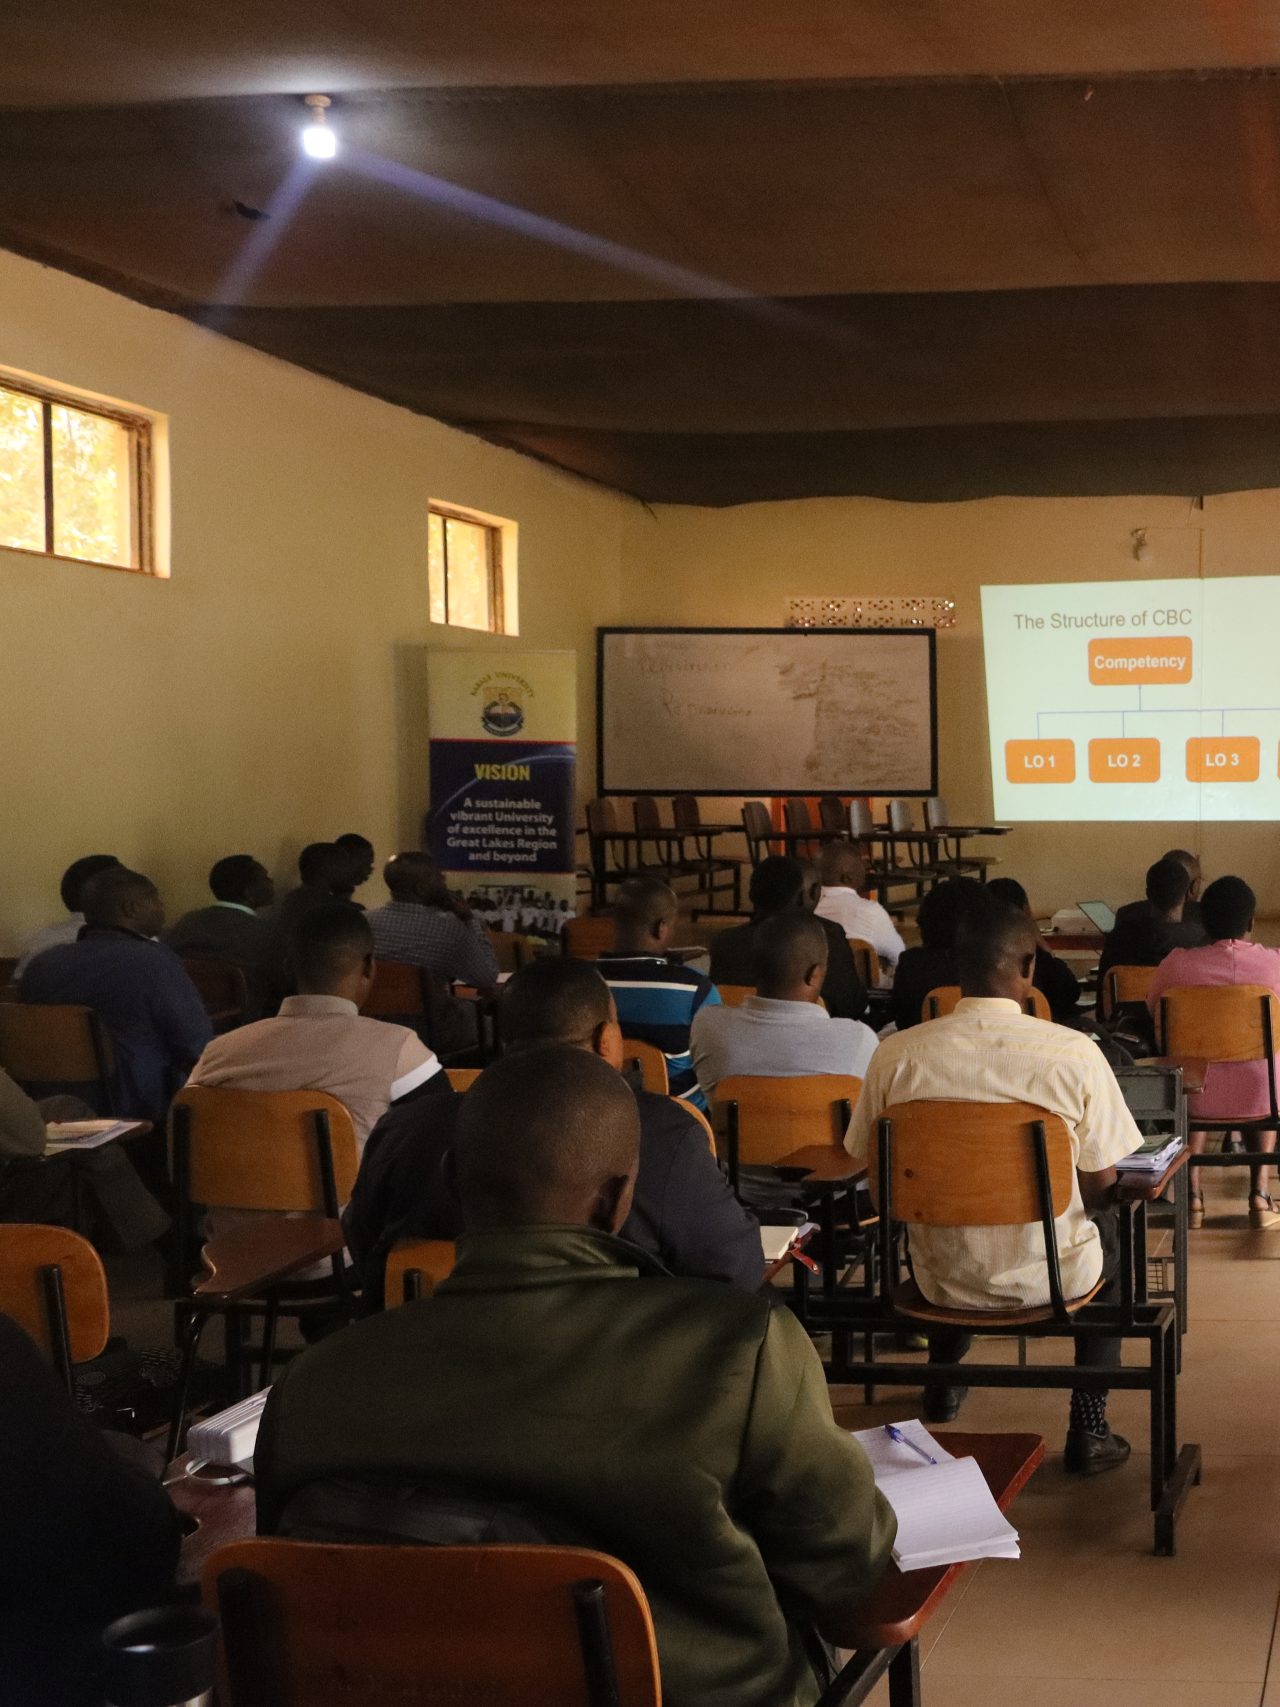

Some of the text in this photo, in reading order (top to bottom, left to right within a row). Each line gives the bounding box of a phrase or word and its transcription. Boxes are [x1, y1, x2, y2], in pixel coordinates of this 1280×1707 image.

[1014, 608, 1192, 630] The Structure of CBC
[1094, 654, 1186, 672] Competency
[1024, 754, 1056, 768] LO 1
[1107, 753, 1142, 768] LO 2
[1205, 753, 1240, 767] LO 3
[474, 763, 530, 780] VISION
[464, 798, 542, 809] A sustainable
[449, 811, 555, 825] vibrant University
[447, 824, 557, 836] of excellence in the
[447, 837, 557, 851] Great Lakes Region
[468, 850, 538, 864] and beyond
